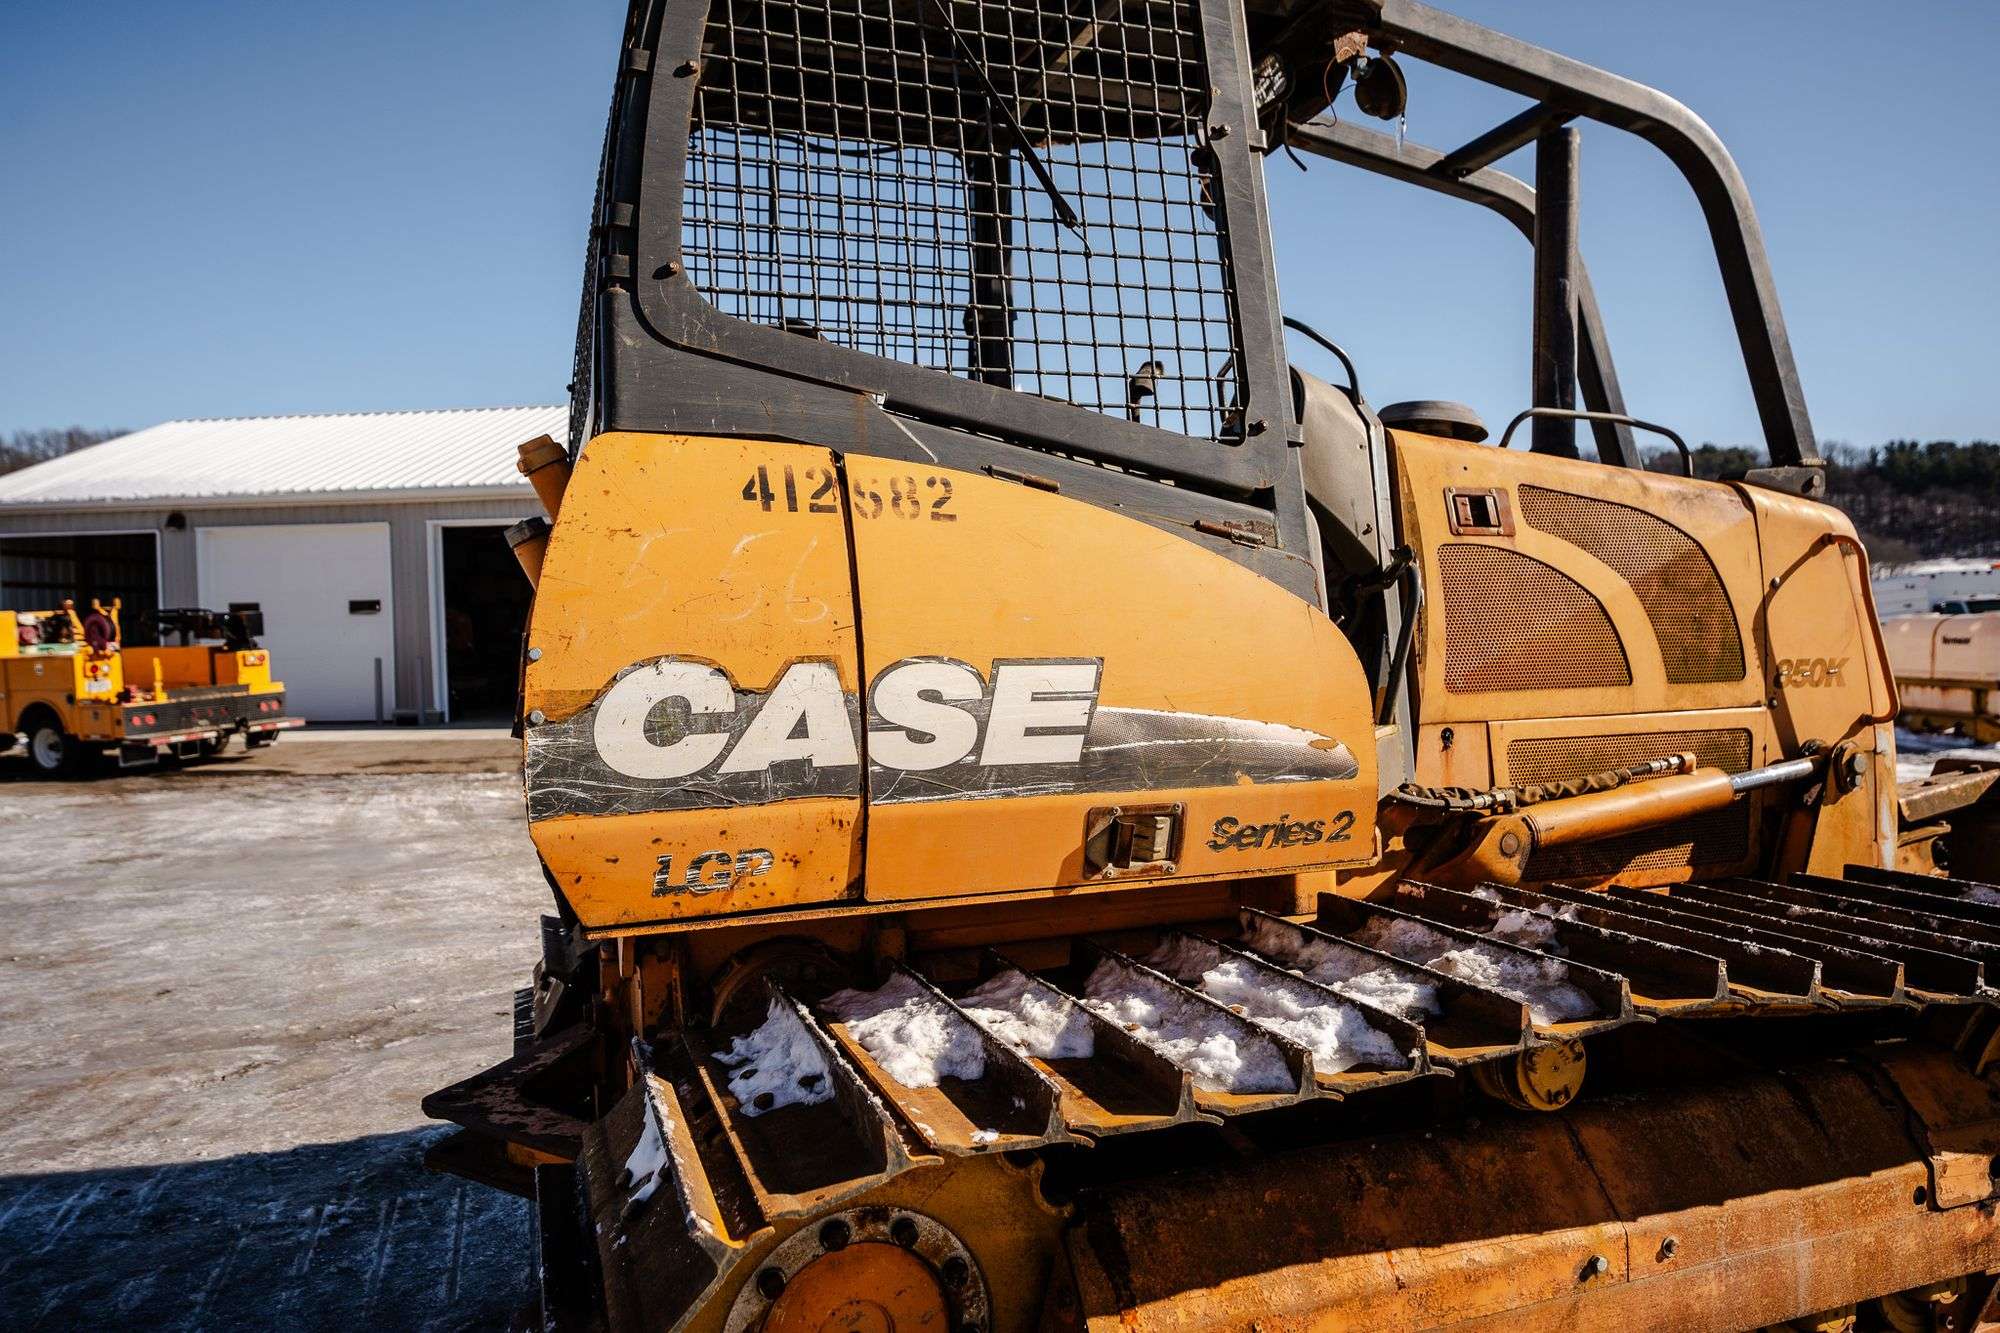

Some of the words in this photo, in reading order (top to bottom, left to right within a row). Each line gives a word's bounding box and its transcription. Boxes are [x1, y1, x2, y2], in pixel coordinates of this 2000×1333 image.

[593, 661, 1099, 780] CASE
[1207, 813, 1326, 853] Series
[1327, 809, 1356, 844] 2
[652, 847, 775, 897] LGP
